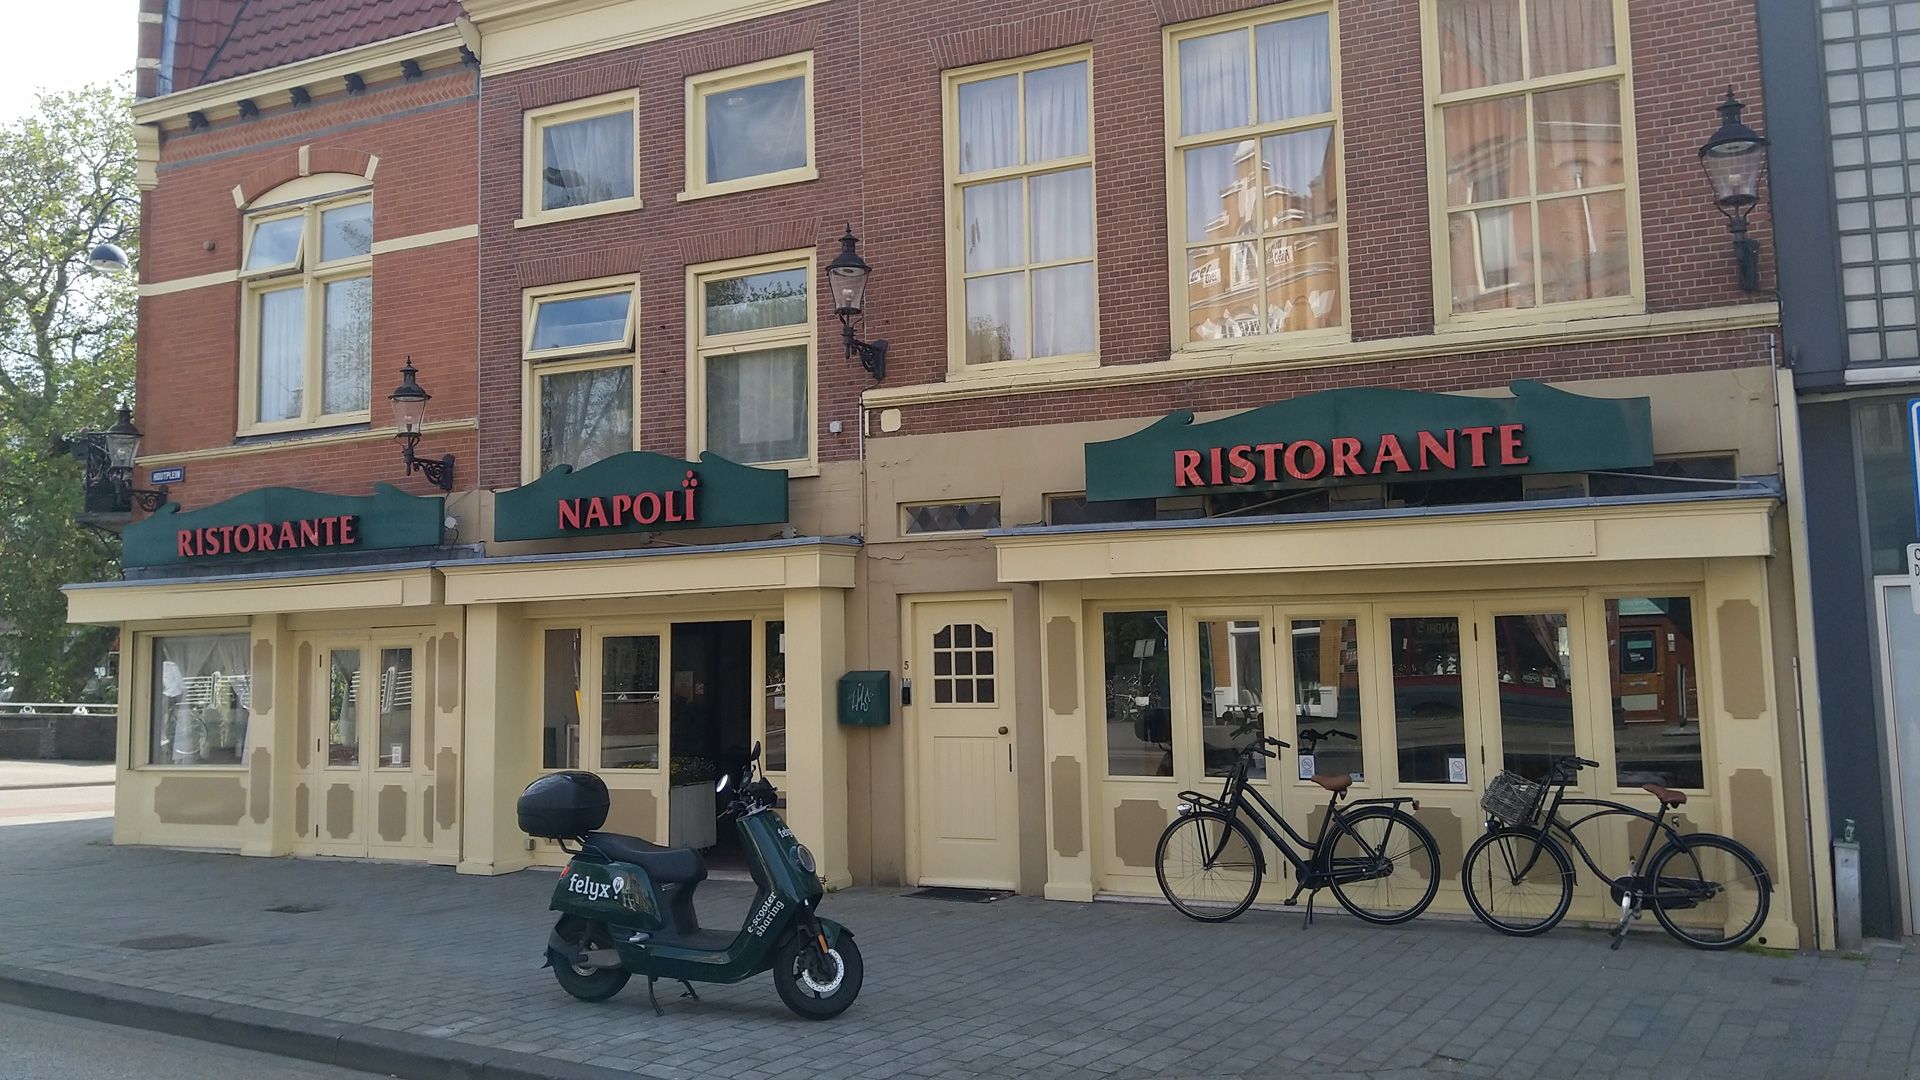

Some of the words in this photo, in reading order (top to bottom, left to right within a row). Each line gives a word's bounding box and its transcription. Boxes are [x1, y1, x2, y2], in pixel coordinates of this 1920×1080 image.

[1174, 423, 1530, 487] RISTORANTE
[178, 515, 355, 557] RISTORANTE
[904, 661, 909, 670] 5
[748, 892, 777, 933] e-scooter
[756, 901, 785, 937] sharing
